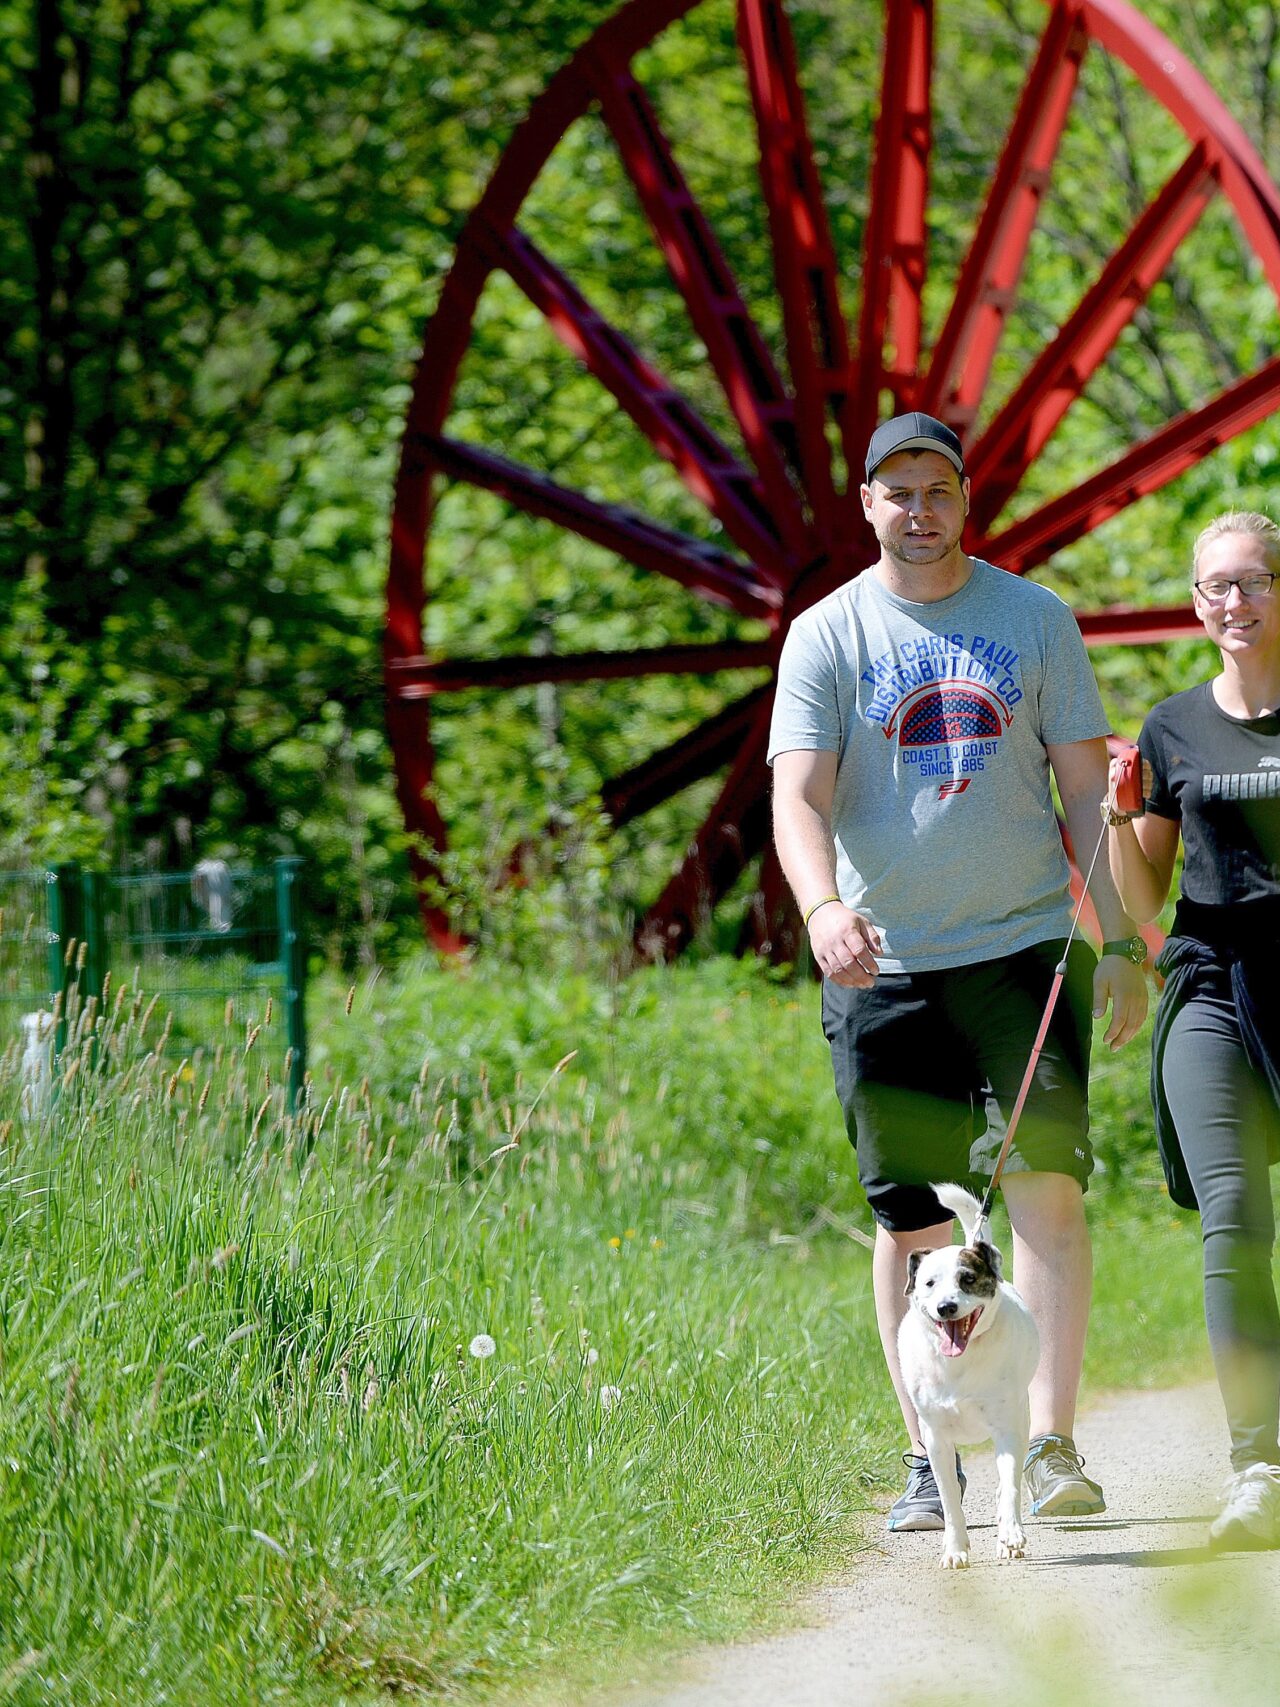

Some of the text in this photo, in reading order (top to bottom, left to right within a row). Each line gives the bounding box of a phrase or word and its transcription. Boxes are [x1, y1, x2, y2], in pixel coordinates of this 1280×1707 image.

[861, 634, 1019, 687] THE CHRIS PAUL
[865, 656, 997, 723] DISTRIBUTION
[902, 742, 998, 764] COAST TO COAST
[920, 761, 954, 776] SINCE
